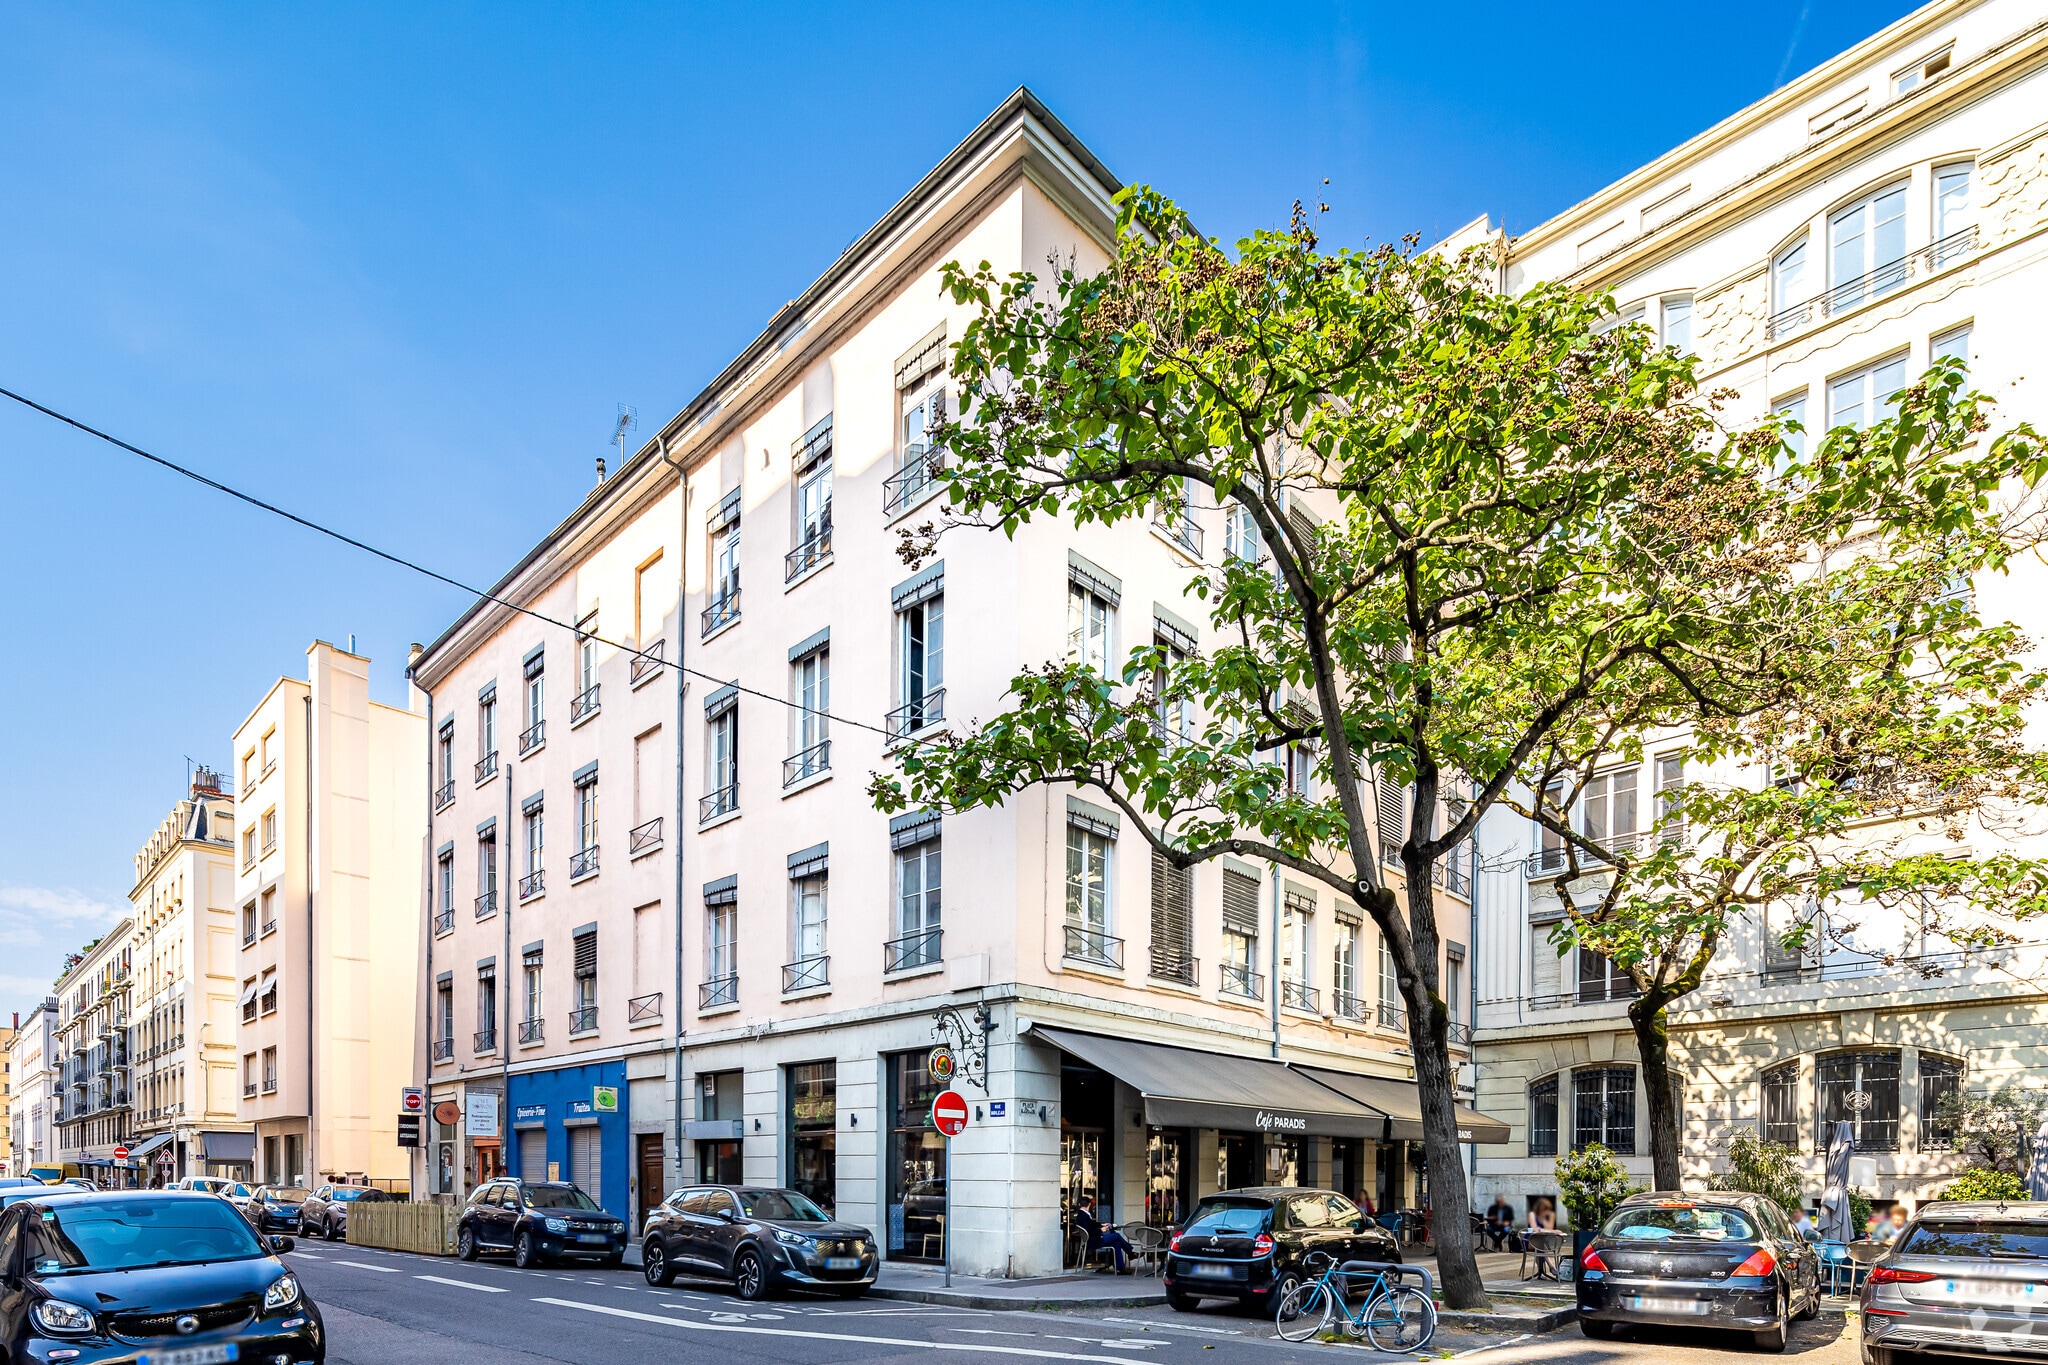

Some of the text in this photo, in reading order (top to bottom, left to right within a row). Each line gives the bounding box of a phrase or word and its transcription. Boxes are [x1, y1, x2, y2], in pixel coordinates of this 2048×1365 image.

[573, 1102, 591, 1113] Traiteu
[1256, 1111, 1306, 1131] Café PARADIS
[1457, 1129, 1472, 1139] RADIS
